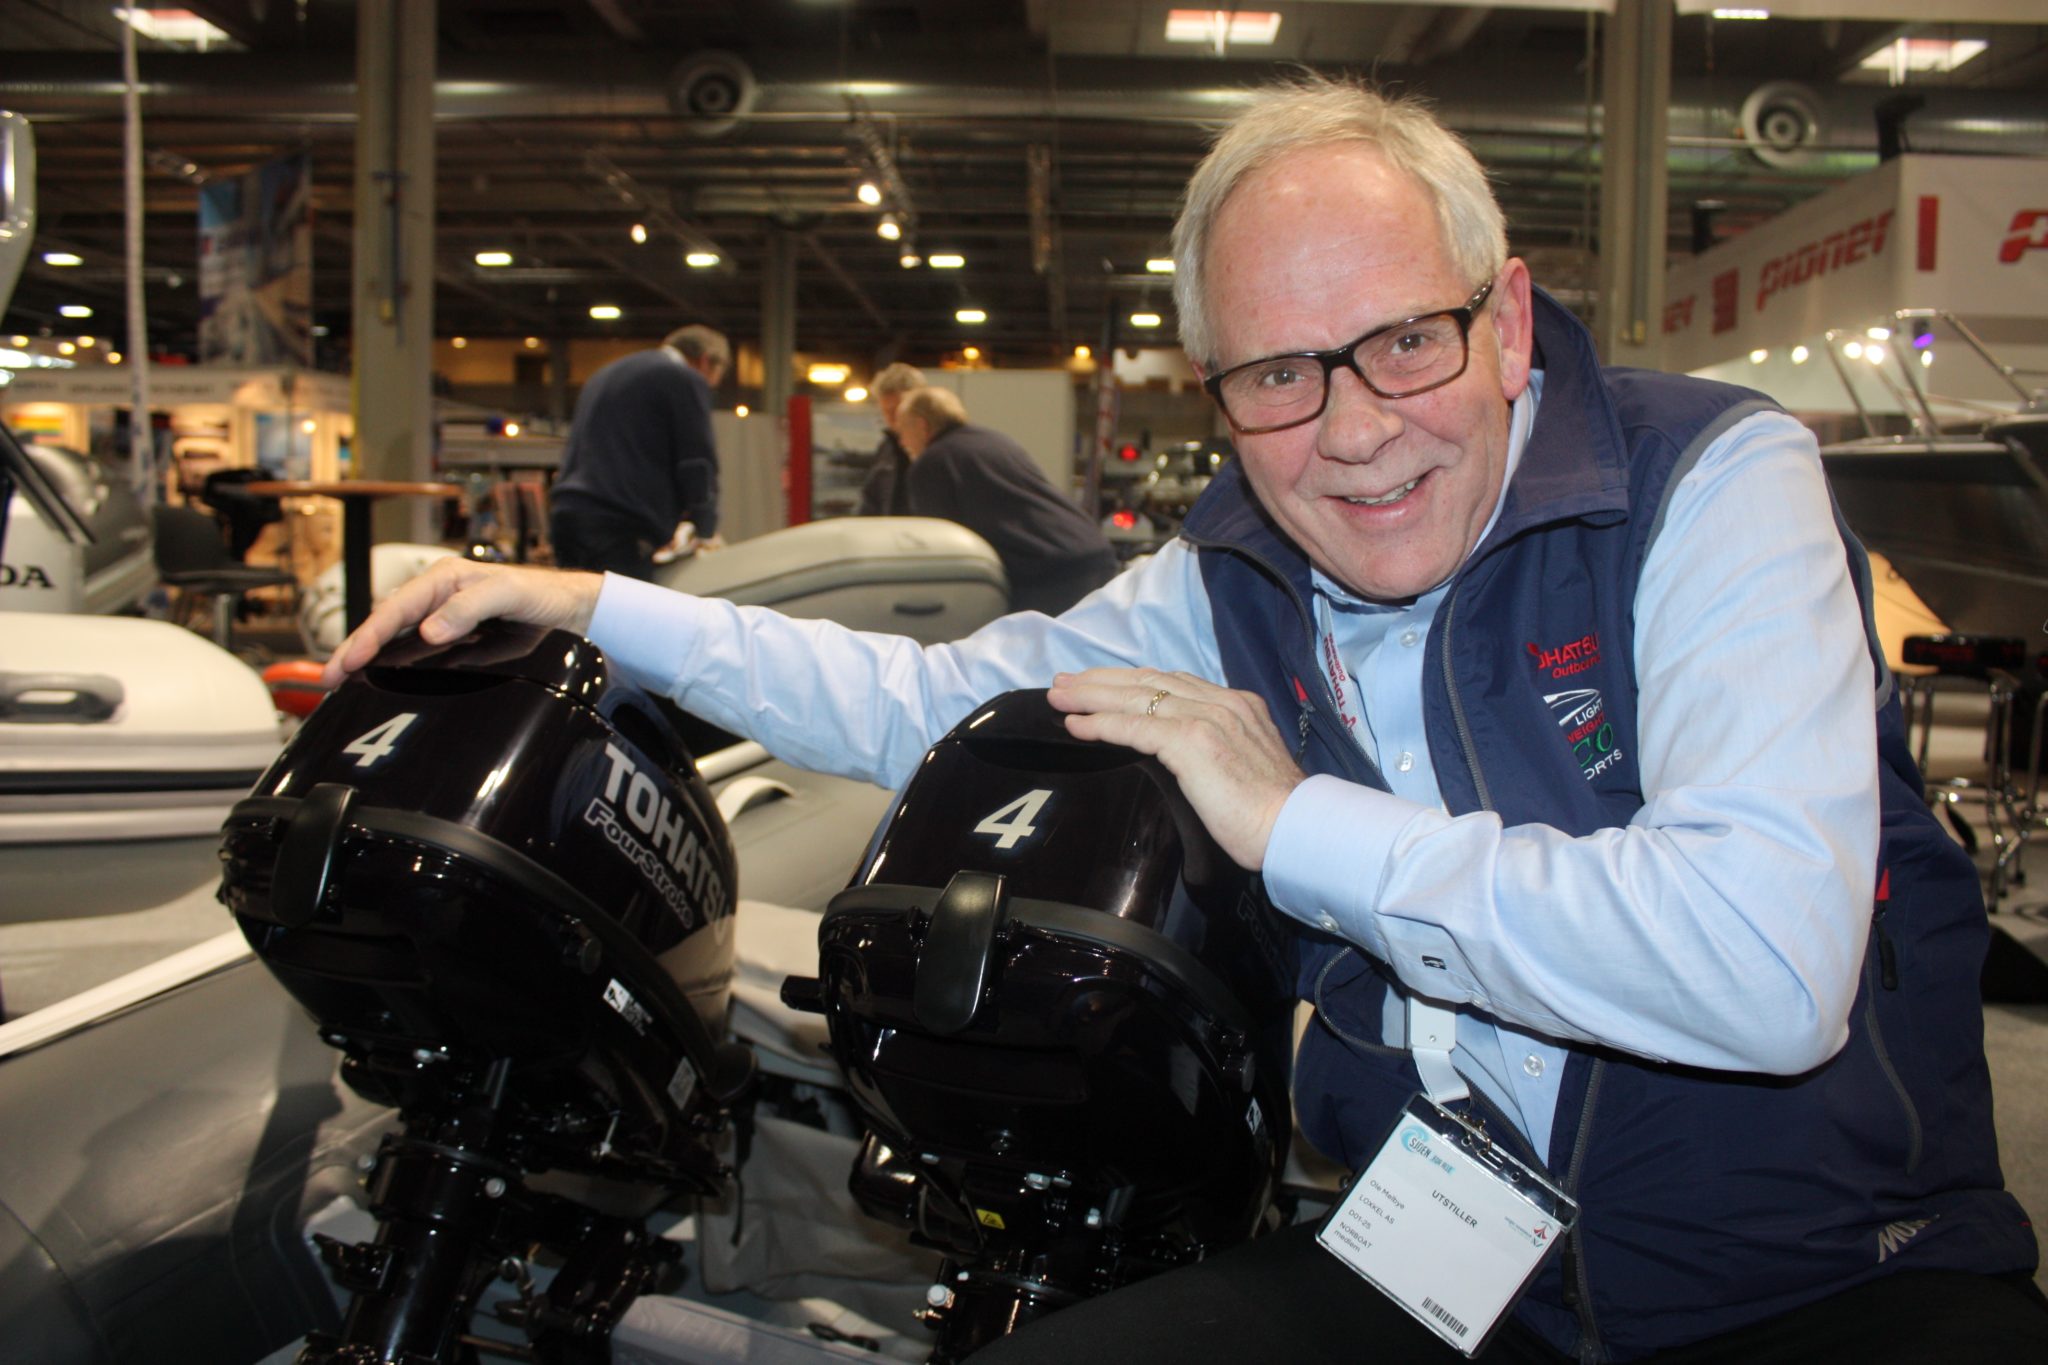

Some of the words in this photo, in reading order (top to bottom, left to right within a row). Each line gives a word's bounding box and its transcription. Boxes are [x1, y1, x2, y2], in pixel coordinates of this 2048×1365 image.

[342, 712, 418, 767] 4
[605, 742, 727, 946] TOHATSU
[973, 789, 1053, 849] 4
[1431, 1189, 1478, 1229] UTSTILLER
